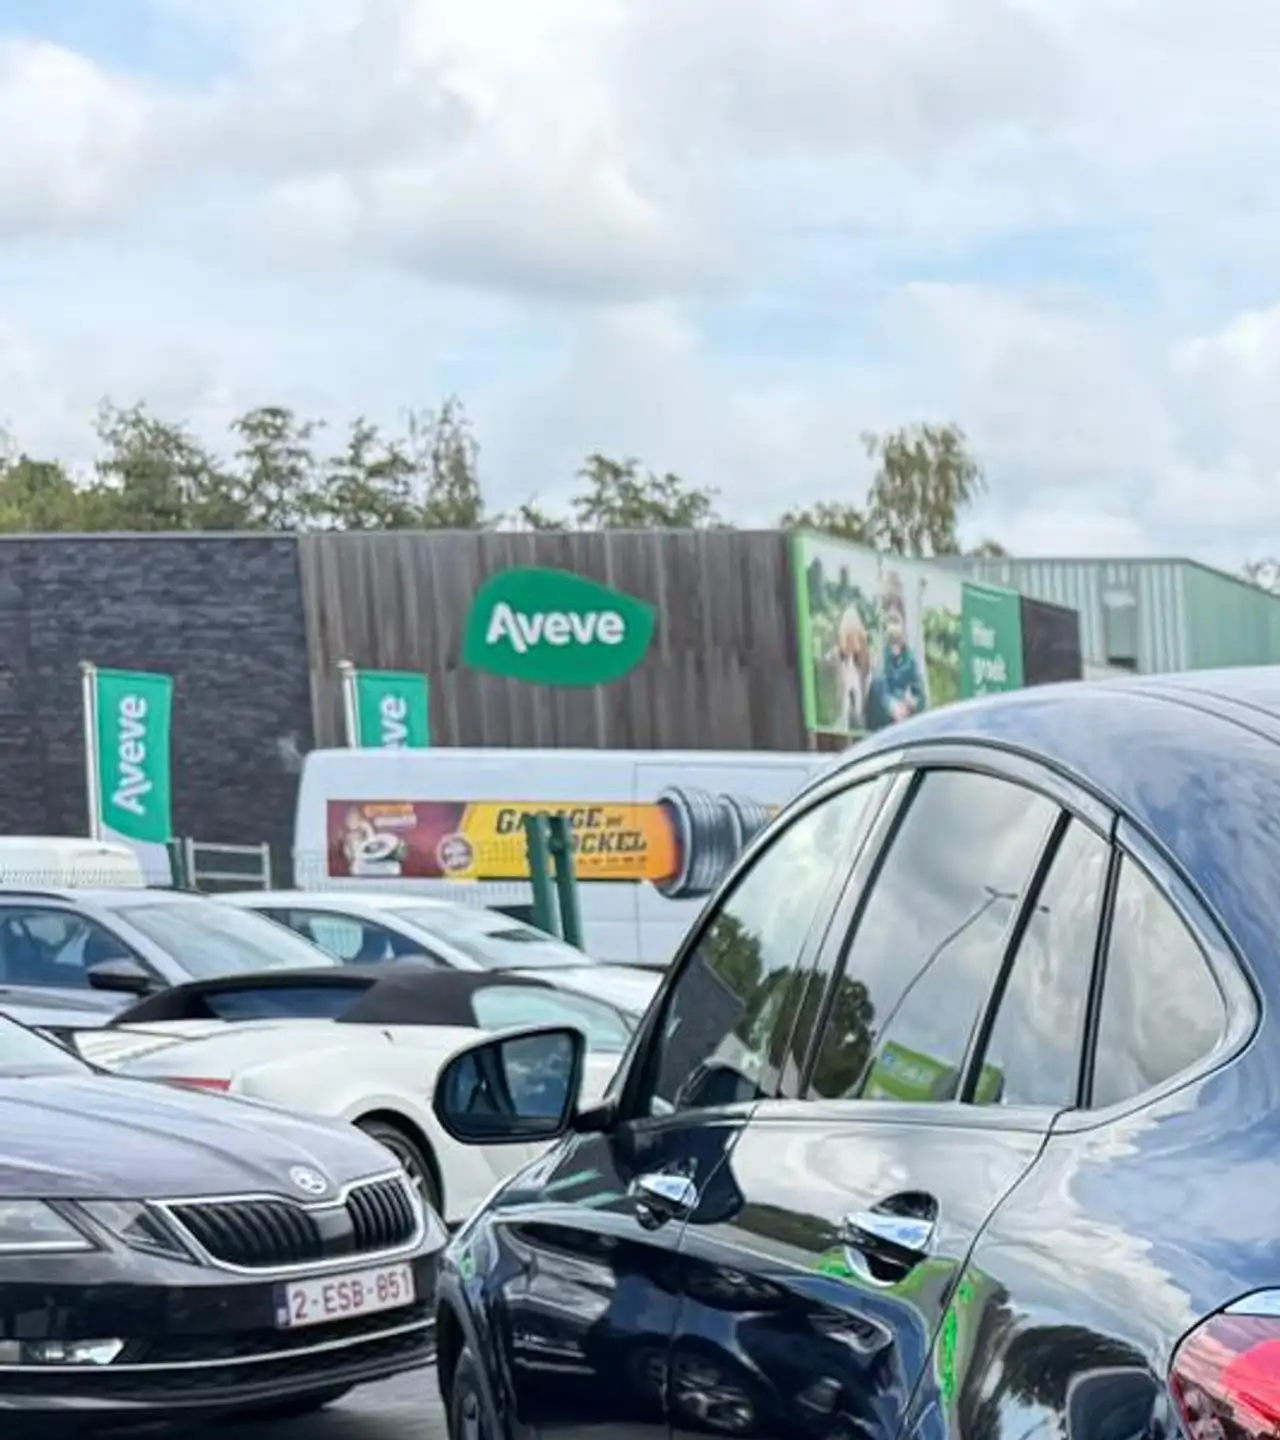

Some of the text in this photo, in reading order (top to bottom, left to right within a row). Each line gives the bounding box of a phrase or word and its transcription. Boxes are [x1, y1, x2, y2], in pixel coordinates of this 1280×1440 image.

[486, 601, 626, 654] Aveve
[380, 694, 408, 748] ve
[112, 694, 152, 816] Aveve
[292, 1269, 410, 1319] 2-ESB-851
